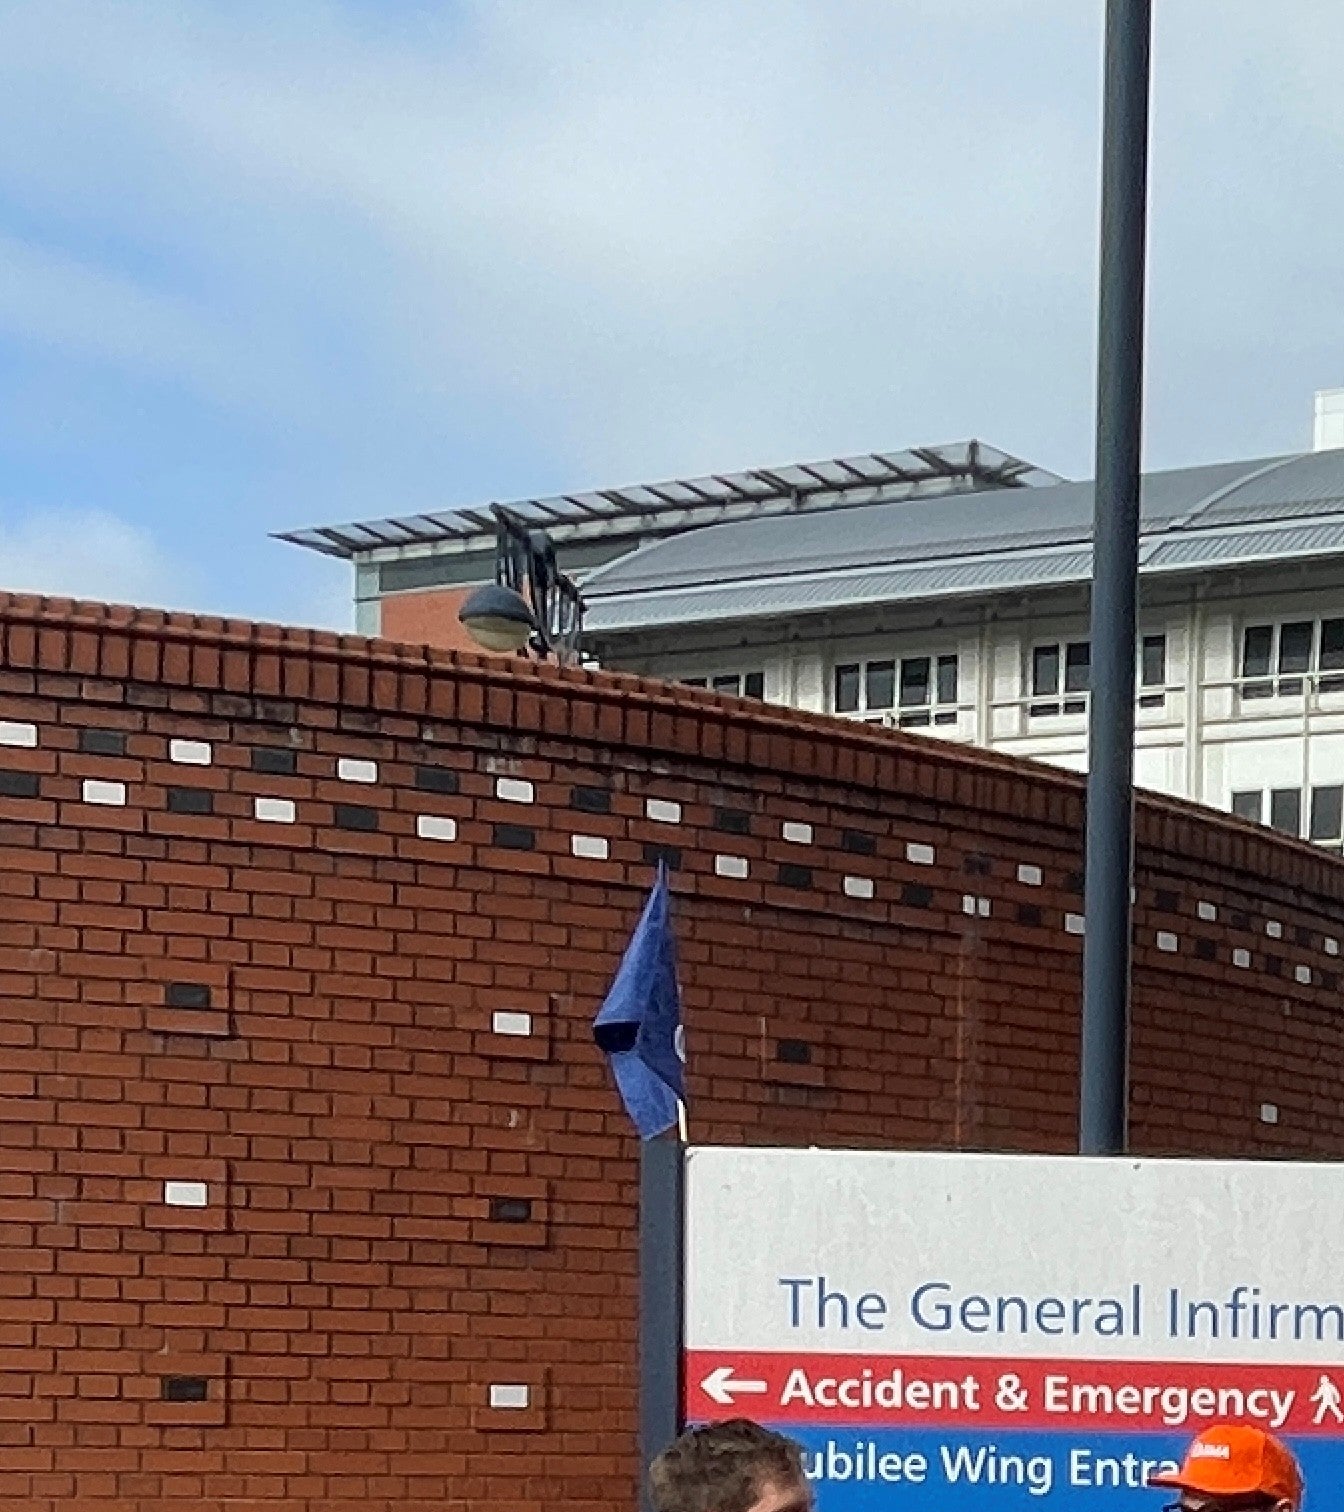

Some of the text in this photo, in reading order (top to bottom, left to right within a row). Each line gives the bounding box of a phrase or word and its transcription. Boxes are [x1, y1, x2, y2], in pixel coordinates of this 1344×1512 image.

[779, 1278, 887, 1330] The
[910, 1282, 1141, 1338] General
[781, 1369, 1296, 1428] Accident & Emergency
[802, 1440, 1179, 1495] ubilee Wing Entra
